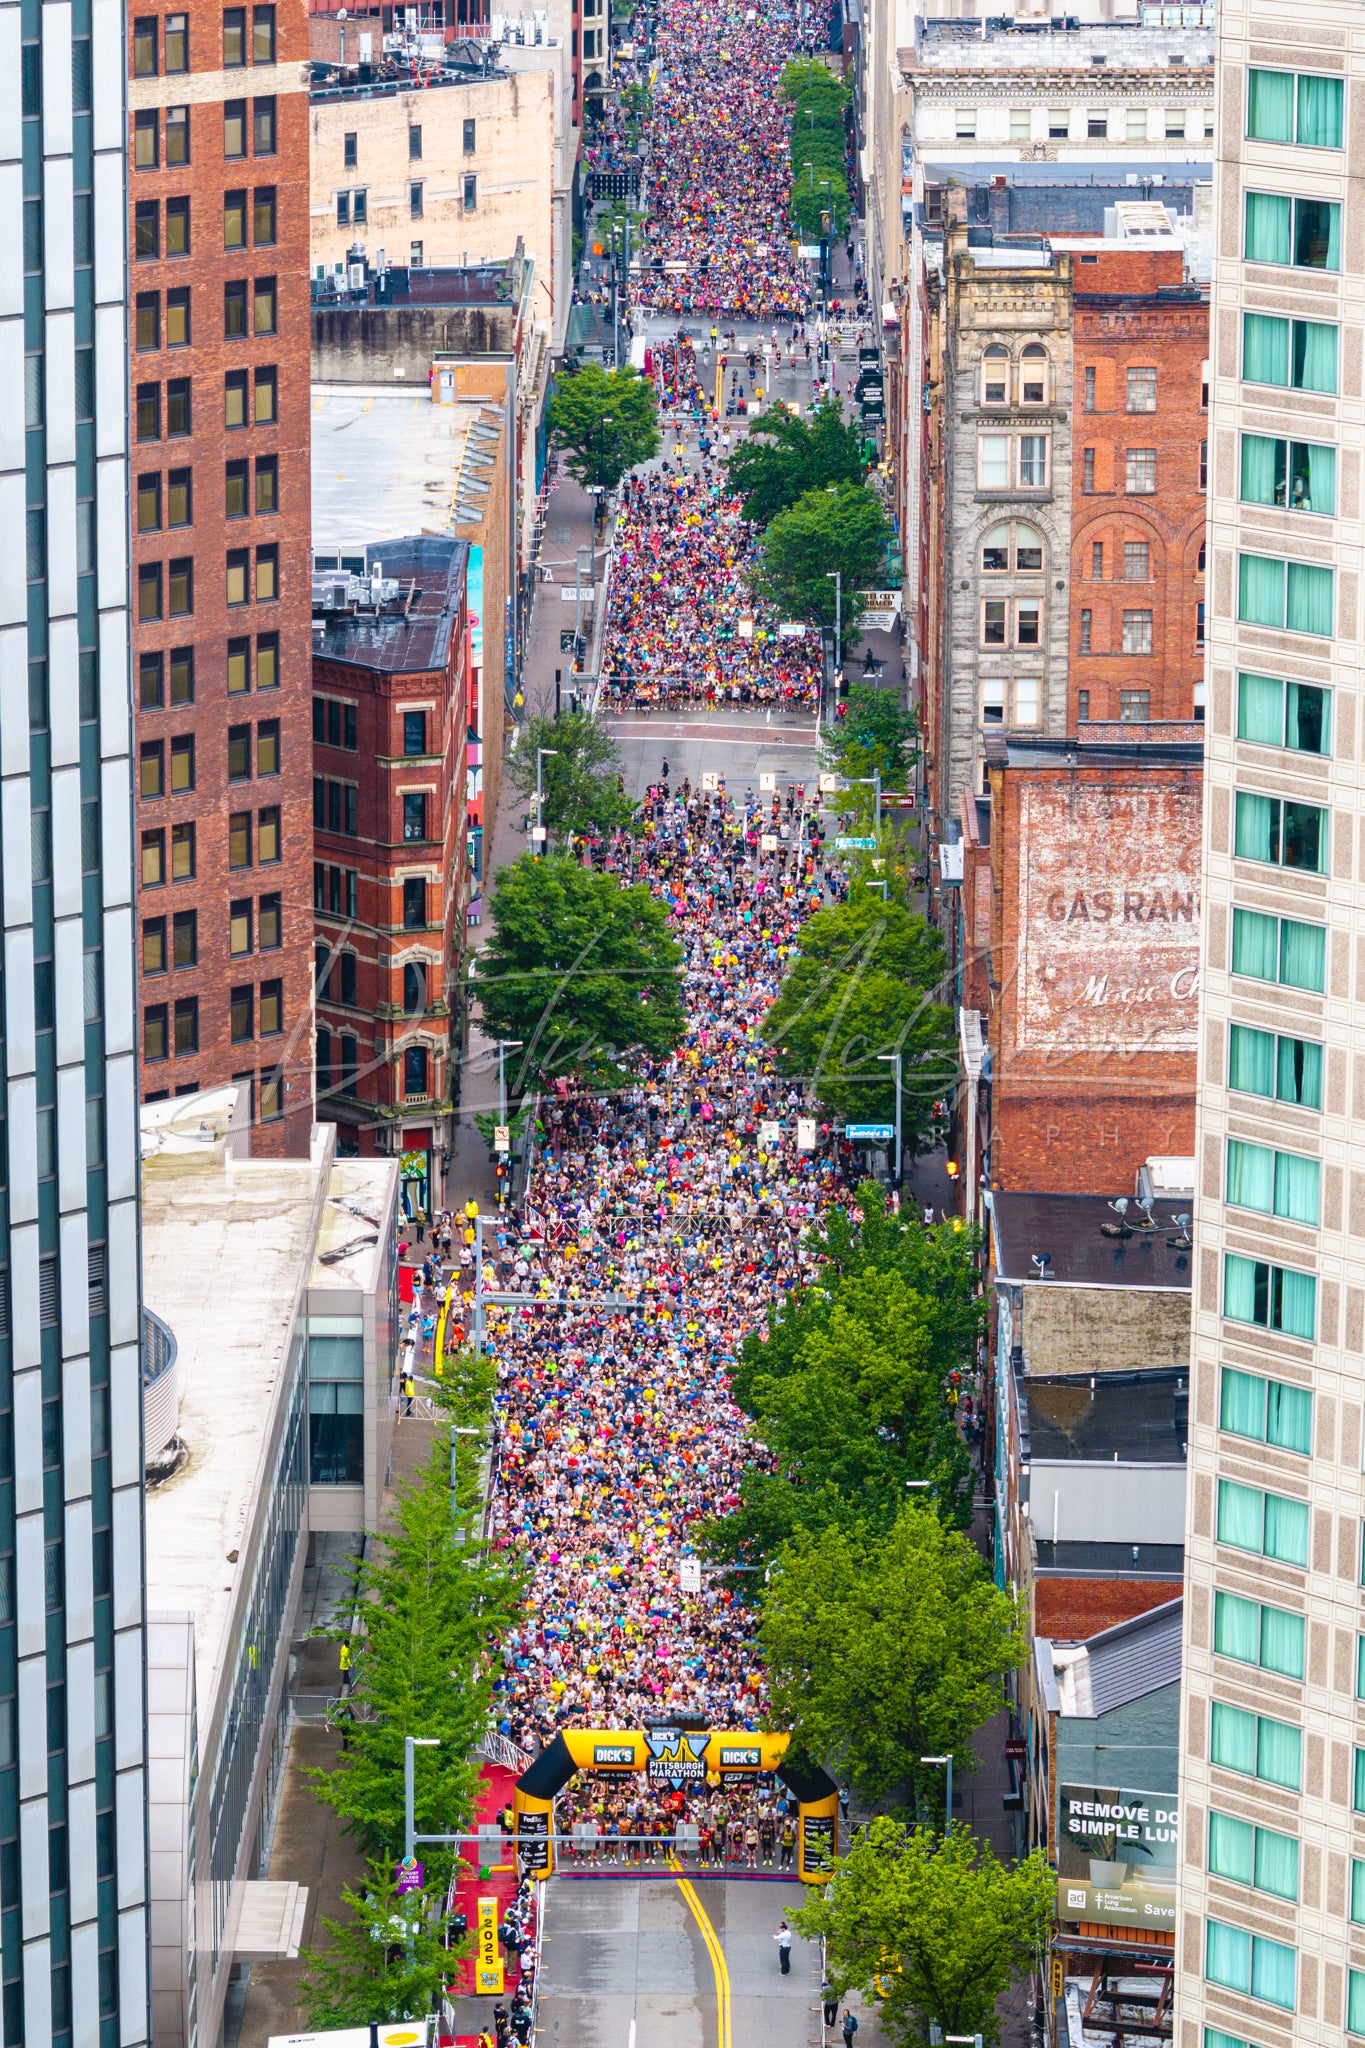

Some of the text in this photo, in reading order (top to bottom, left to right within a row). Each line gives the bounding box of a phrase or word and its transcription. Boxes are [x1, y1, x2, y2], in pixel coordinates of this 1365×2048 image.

[1047, 890, 1200, 923] GAS RAN
[651, 1732, 675, 1741] DICK'S
[596, 1749, 632, 1762] DICK'S
[723, 1750, 758, 1764] DICK'S
[649, 1761, 704, 1769] PITTSBURGH
[649, 1769, 704, 1778] MARATHON
[1069, 1800, 1149, 1822] REMOVE
[1068, 1818, 1140, 1839] SIMPLE
[1070, 1892, 1084, 1902] ad
[1104, 1893, 1133, 1902] American
[1144, 1904, 1175, 1917] Save
[483, 1918, 494, 1965] 2025
